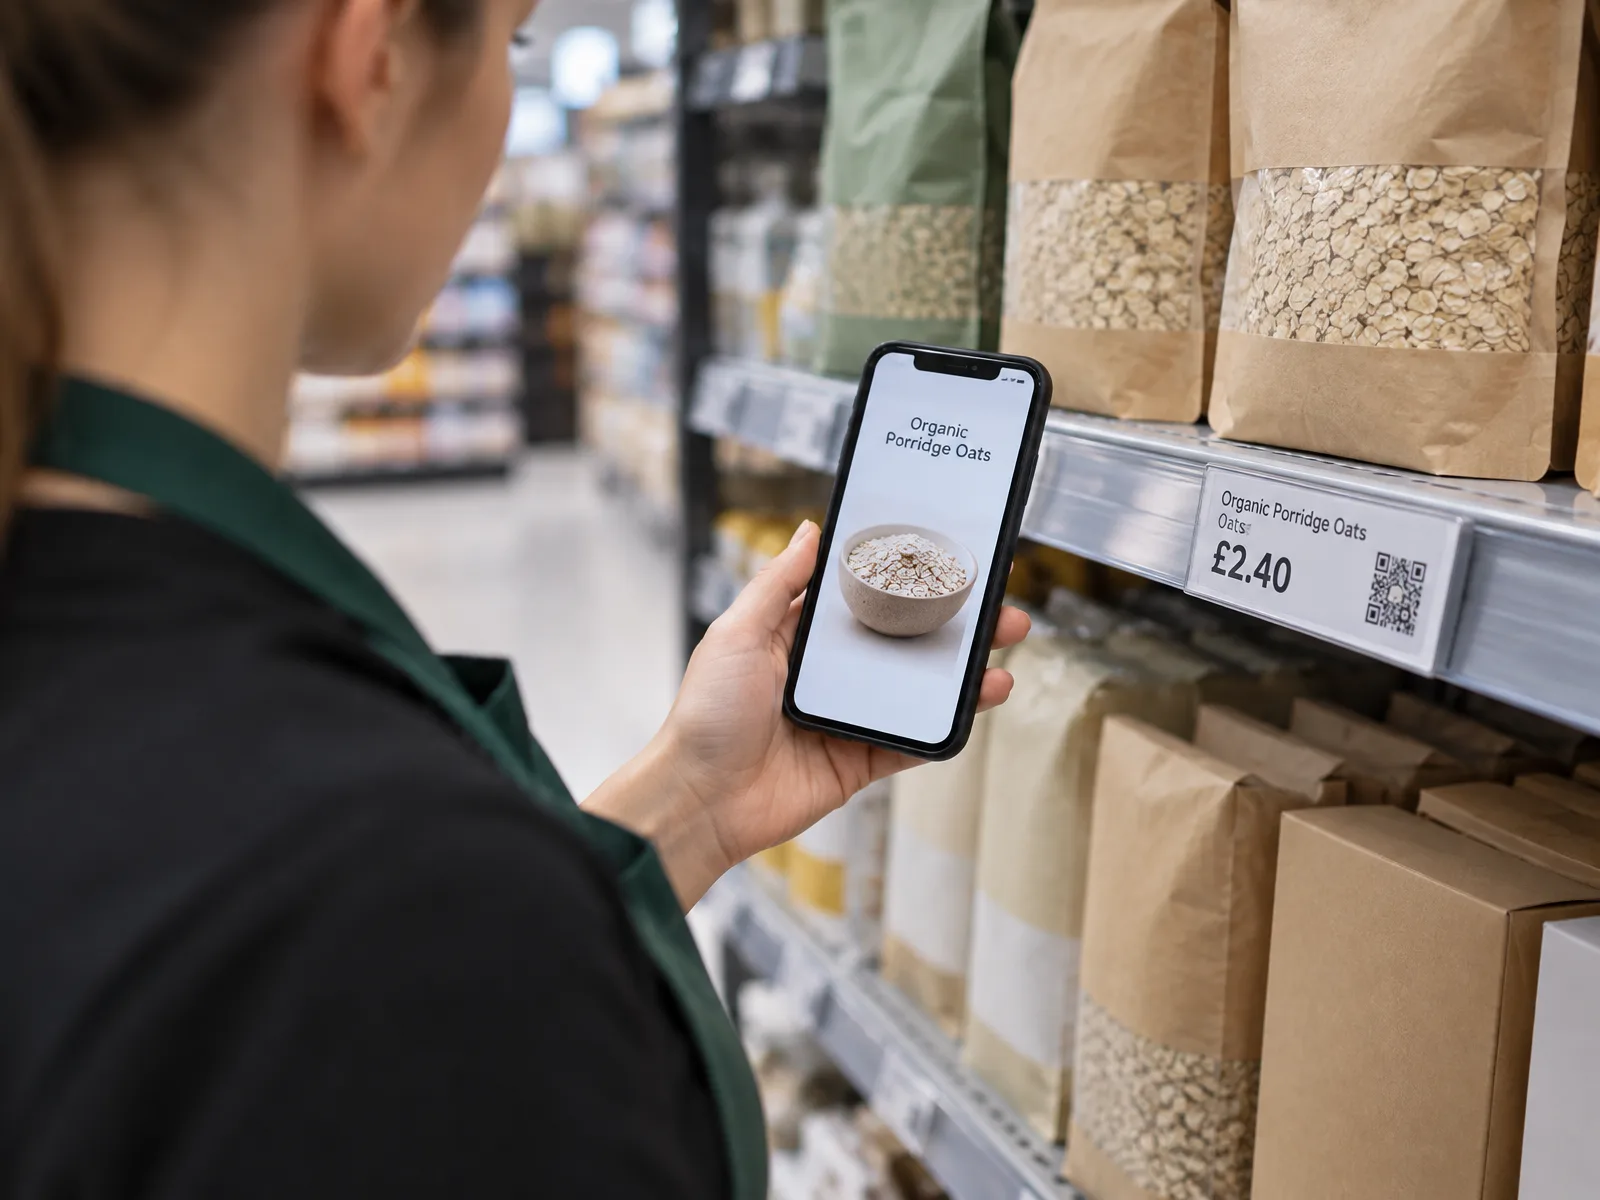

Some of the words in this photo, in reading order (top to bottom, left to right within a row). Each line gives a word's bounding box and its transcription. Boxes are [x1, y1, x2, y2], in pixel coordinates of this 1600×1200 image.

[885, 431, 951, 457] Porridge
[955, 444, 992, 462] Oats
[910, 417, 969, 439] Organic
[1221, 490, 1270, 516] Organic
[1272, 502, 1330, 533] Porridge
[1333, 518, 1367, 541] Oats
[1210, 540, 1292, 594] £2.40
